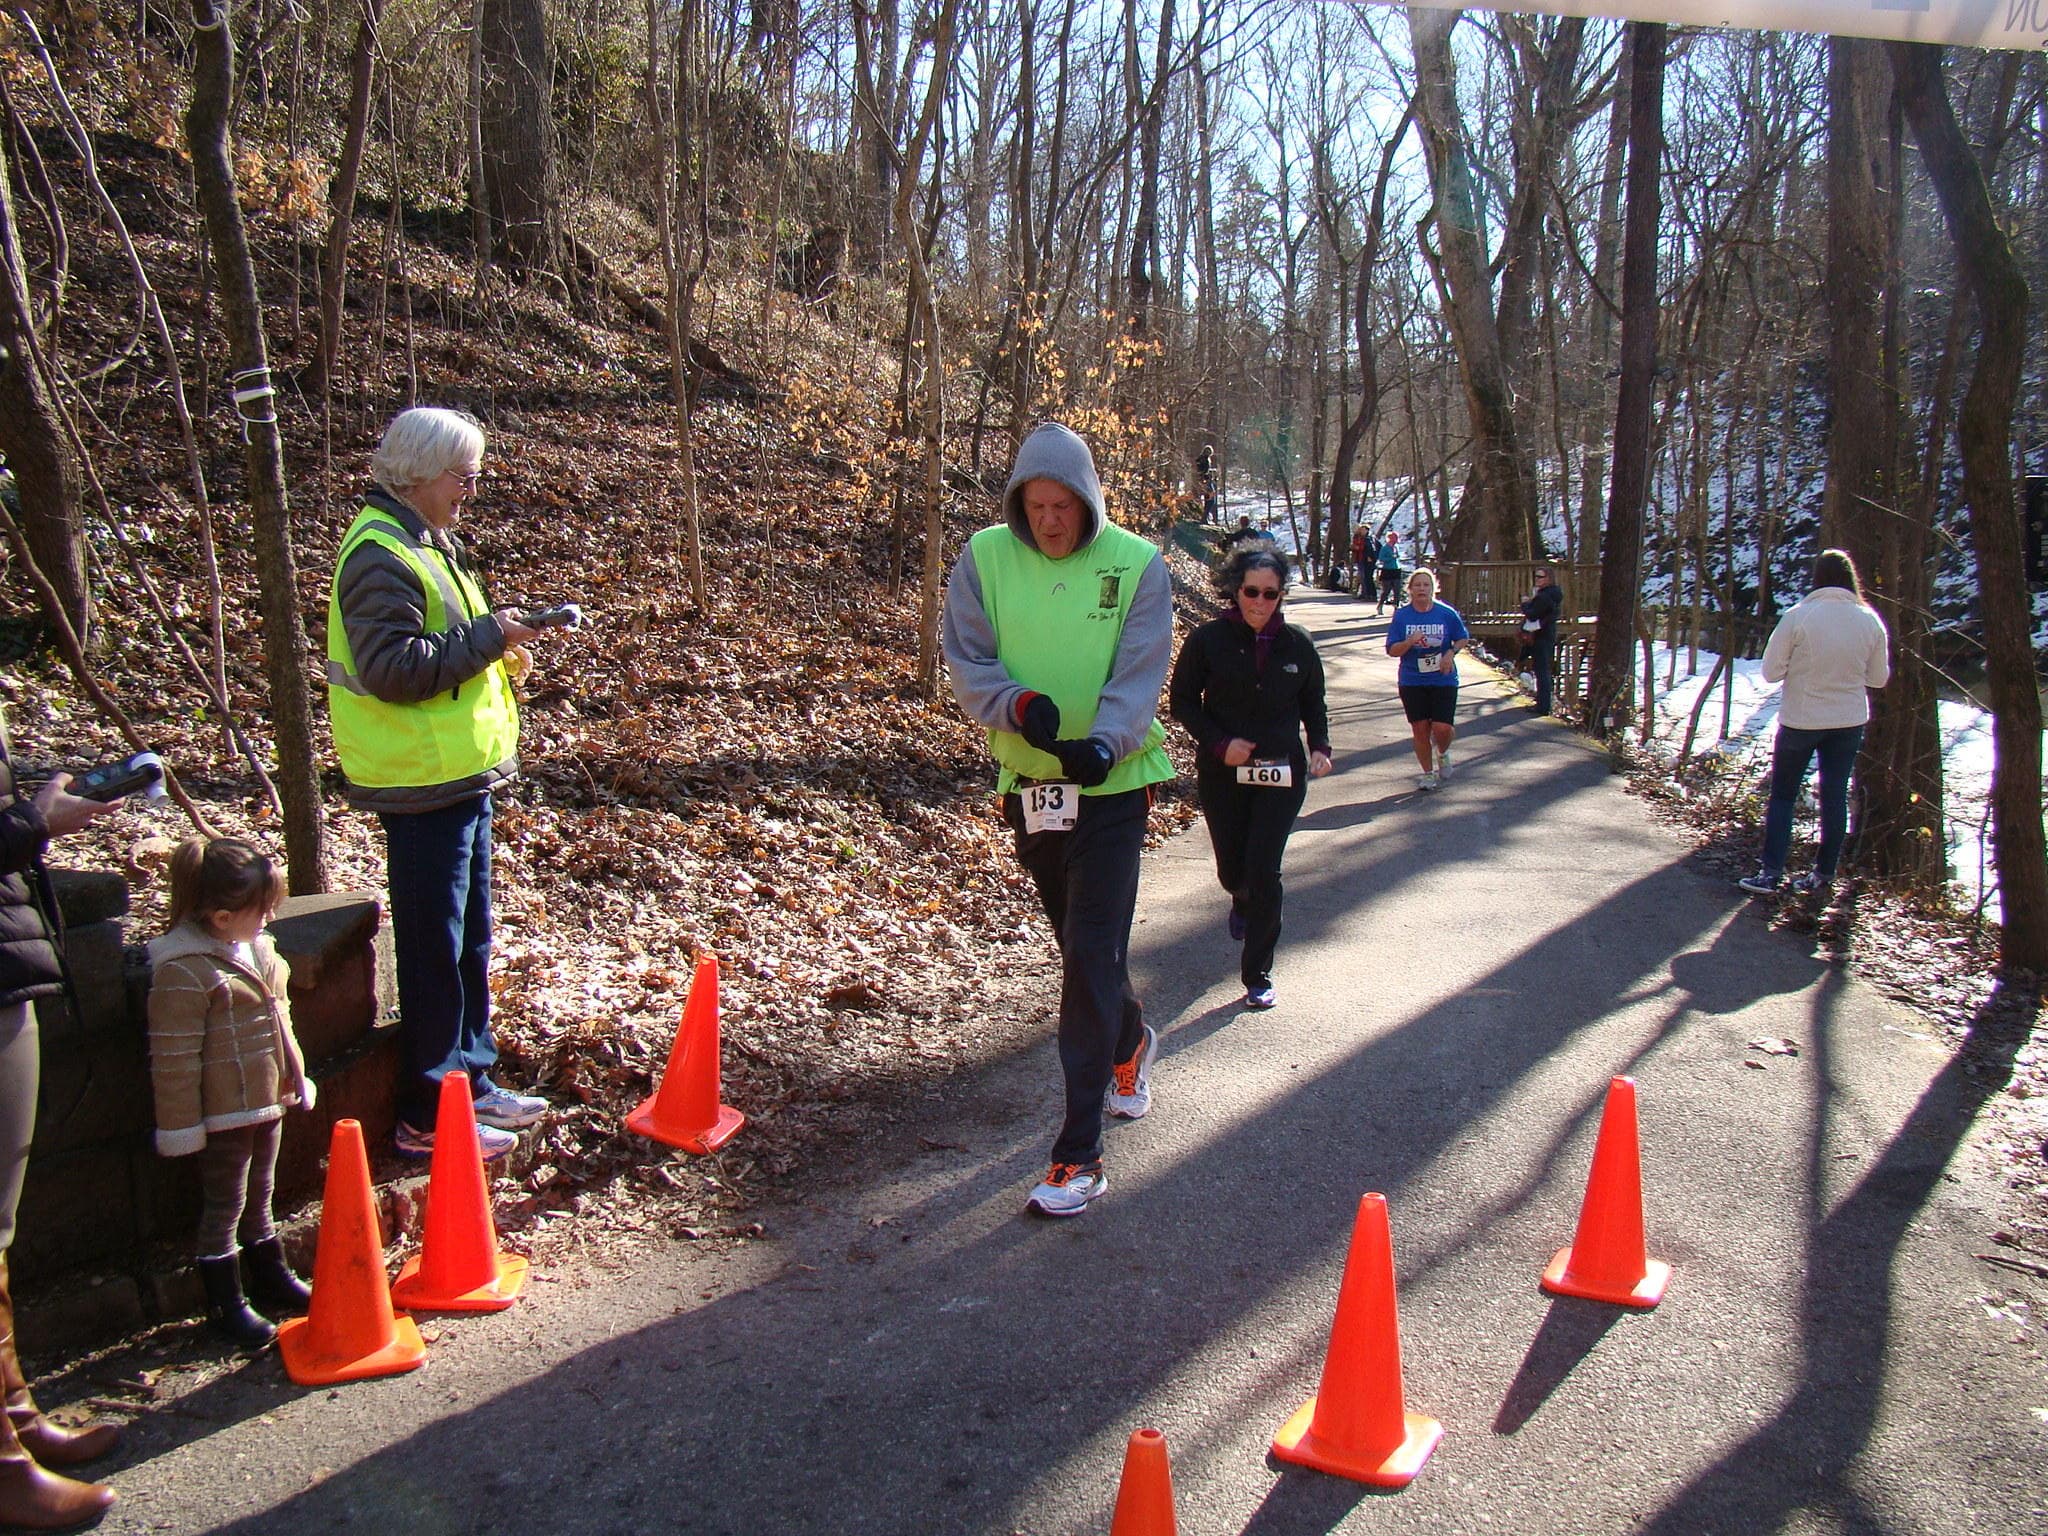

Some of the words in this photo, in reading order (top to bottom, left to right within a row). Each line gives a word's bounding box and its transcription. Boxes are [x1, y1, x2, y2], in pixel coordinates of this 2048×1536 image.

[1405, 624, 1444, 635] FREEDOM
[1247, 768, 1281, 782] 160
[1031, 786, 1064, 812] 153
